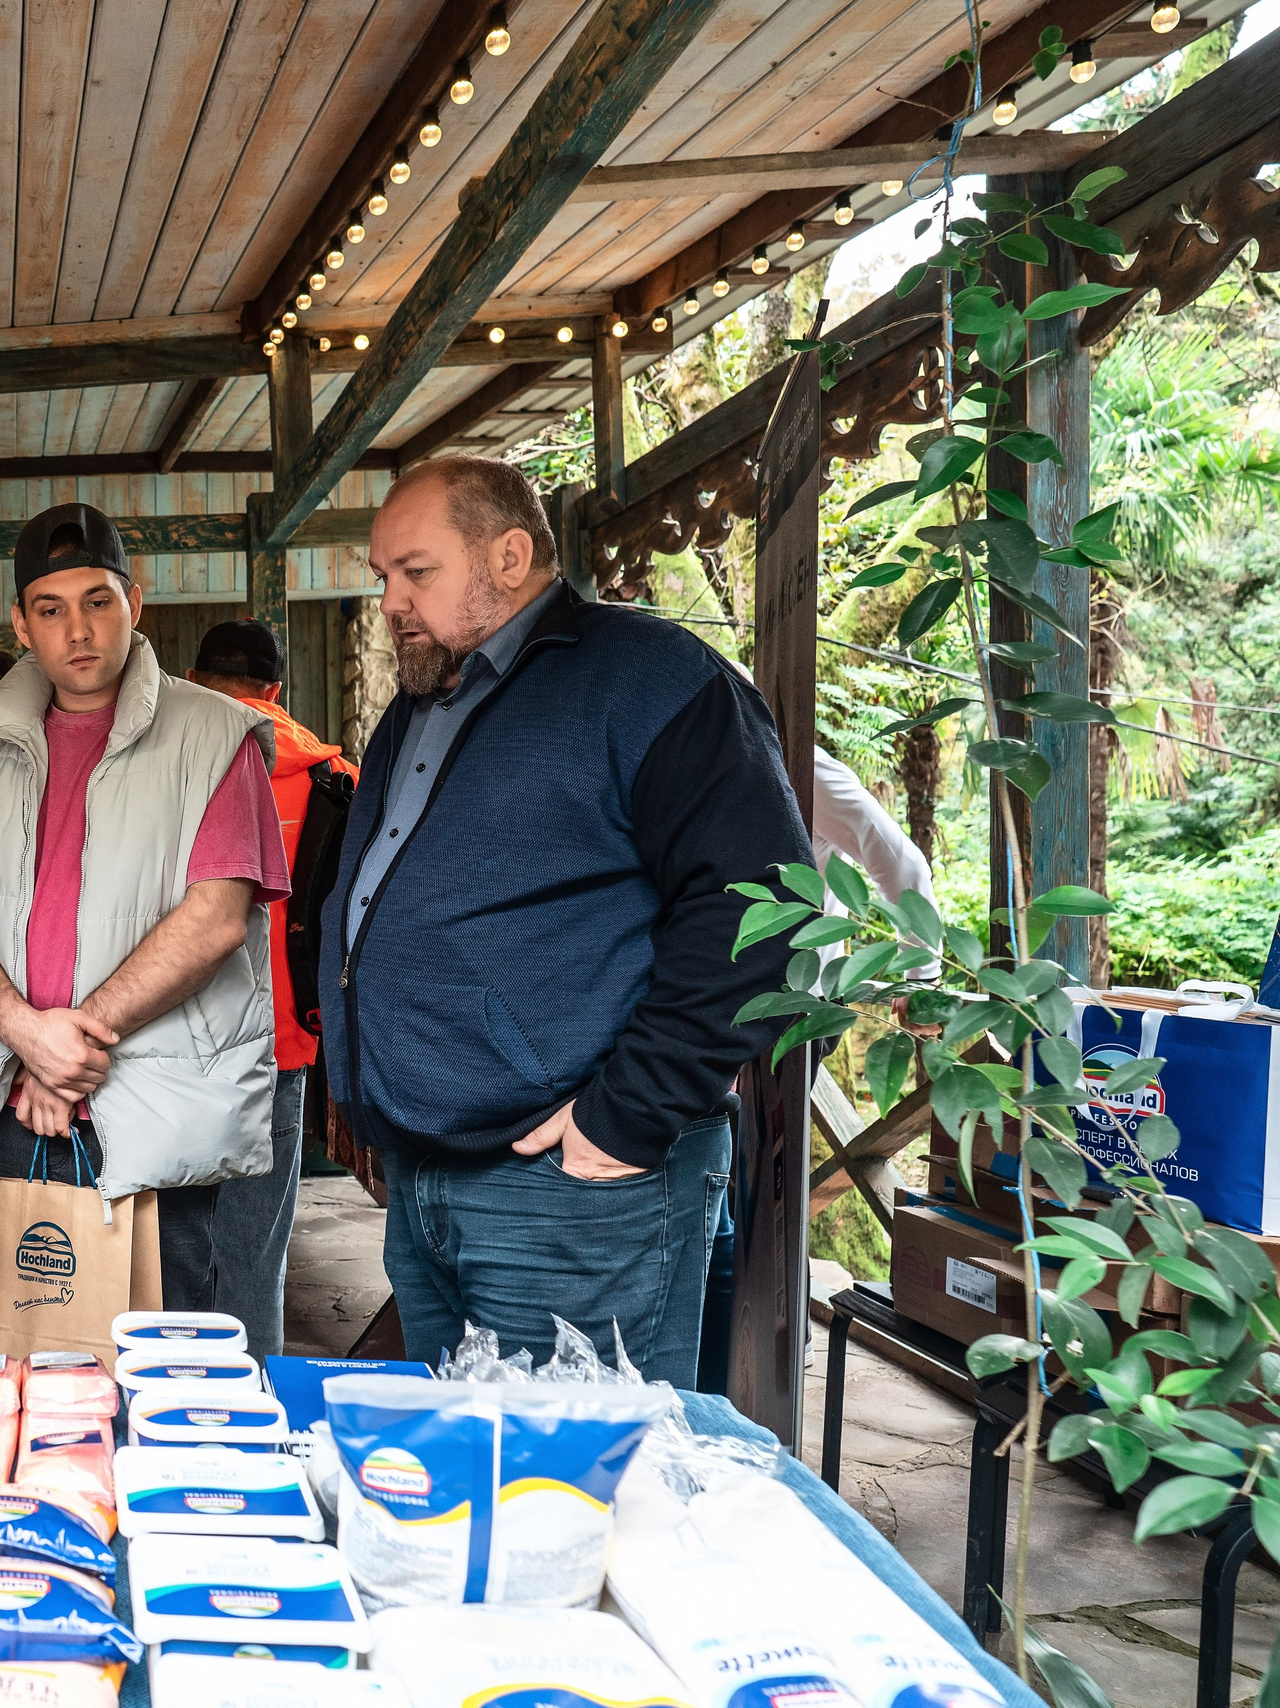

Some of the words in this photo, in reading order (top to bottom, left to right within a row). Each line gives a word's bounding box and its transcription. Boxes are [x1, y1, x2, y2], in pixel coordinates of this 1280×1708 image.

[1118, 1137, 1127, 1149] В
[1079, 1144, 1199, 1182] РОФЕССИОНАЛОВ
[21, 1251, 71, 1270] Hochland
